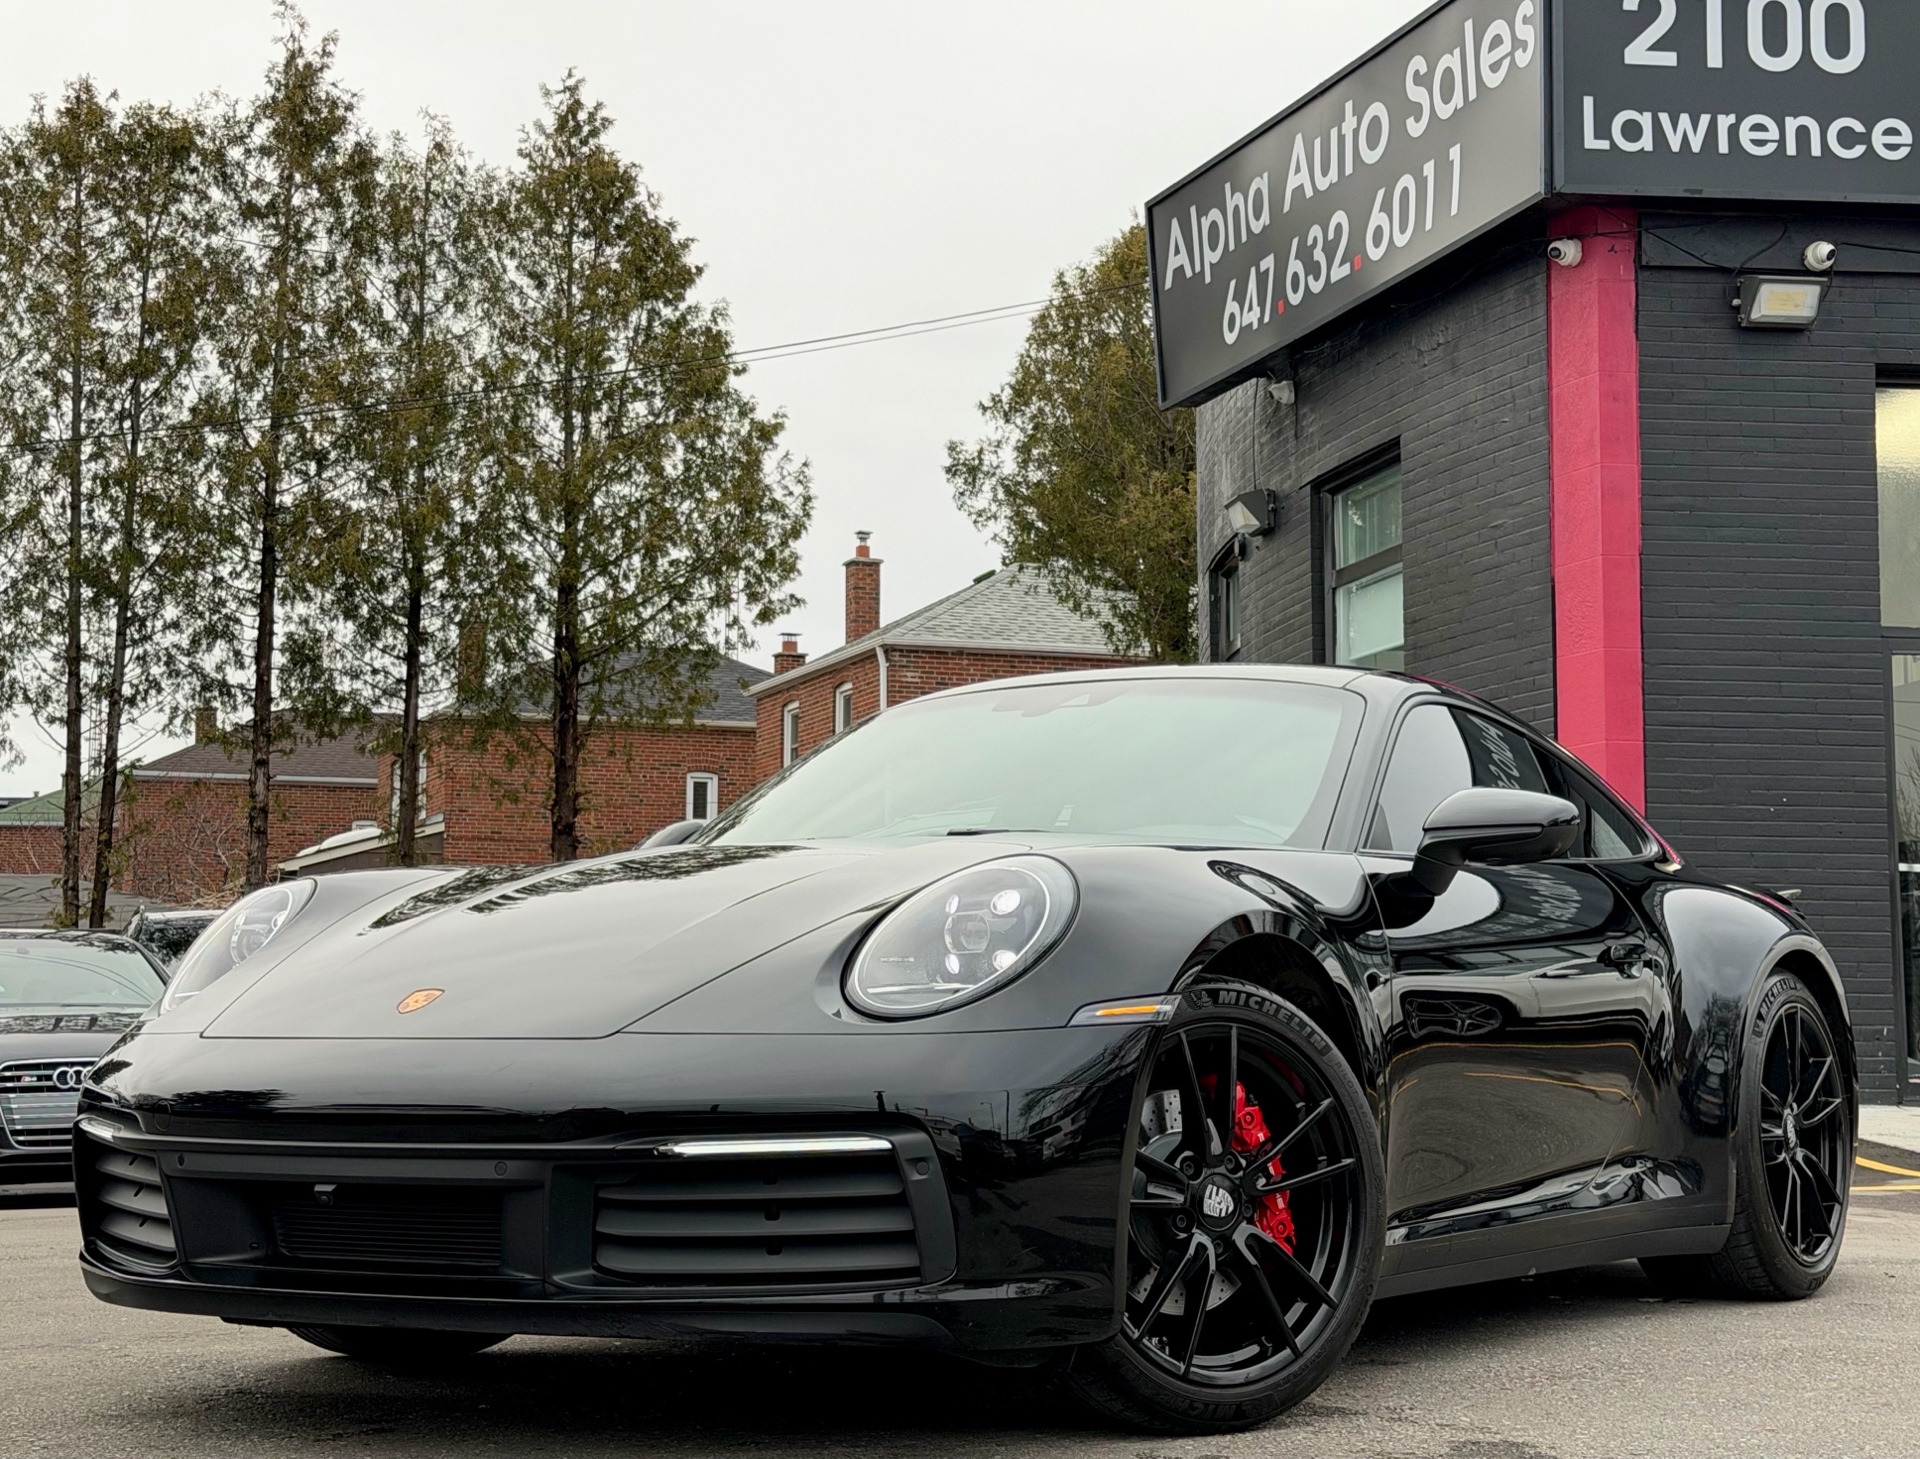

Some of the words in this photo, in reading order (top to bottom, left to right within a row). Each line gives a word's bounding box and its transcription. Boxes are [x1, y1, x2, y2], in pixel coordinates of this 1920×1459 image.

[1622, 0, 1865, 74] 2100
[1164, 171, 1271, 291] Alpha
[1283, 99, 1389, 214] Auto
[1405, 0, 1535, 138] Sales
[1583, 95, 1913, 161] Lawrence
[1222, 142, 1461, 345] 647.632.6011
[1218, 990, 1327, 1050] MICHELIN
[1334, 1061, 1359, 1096] PILOT
